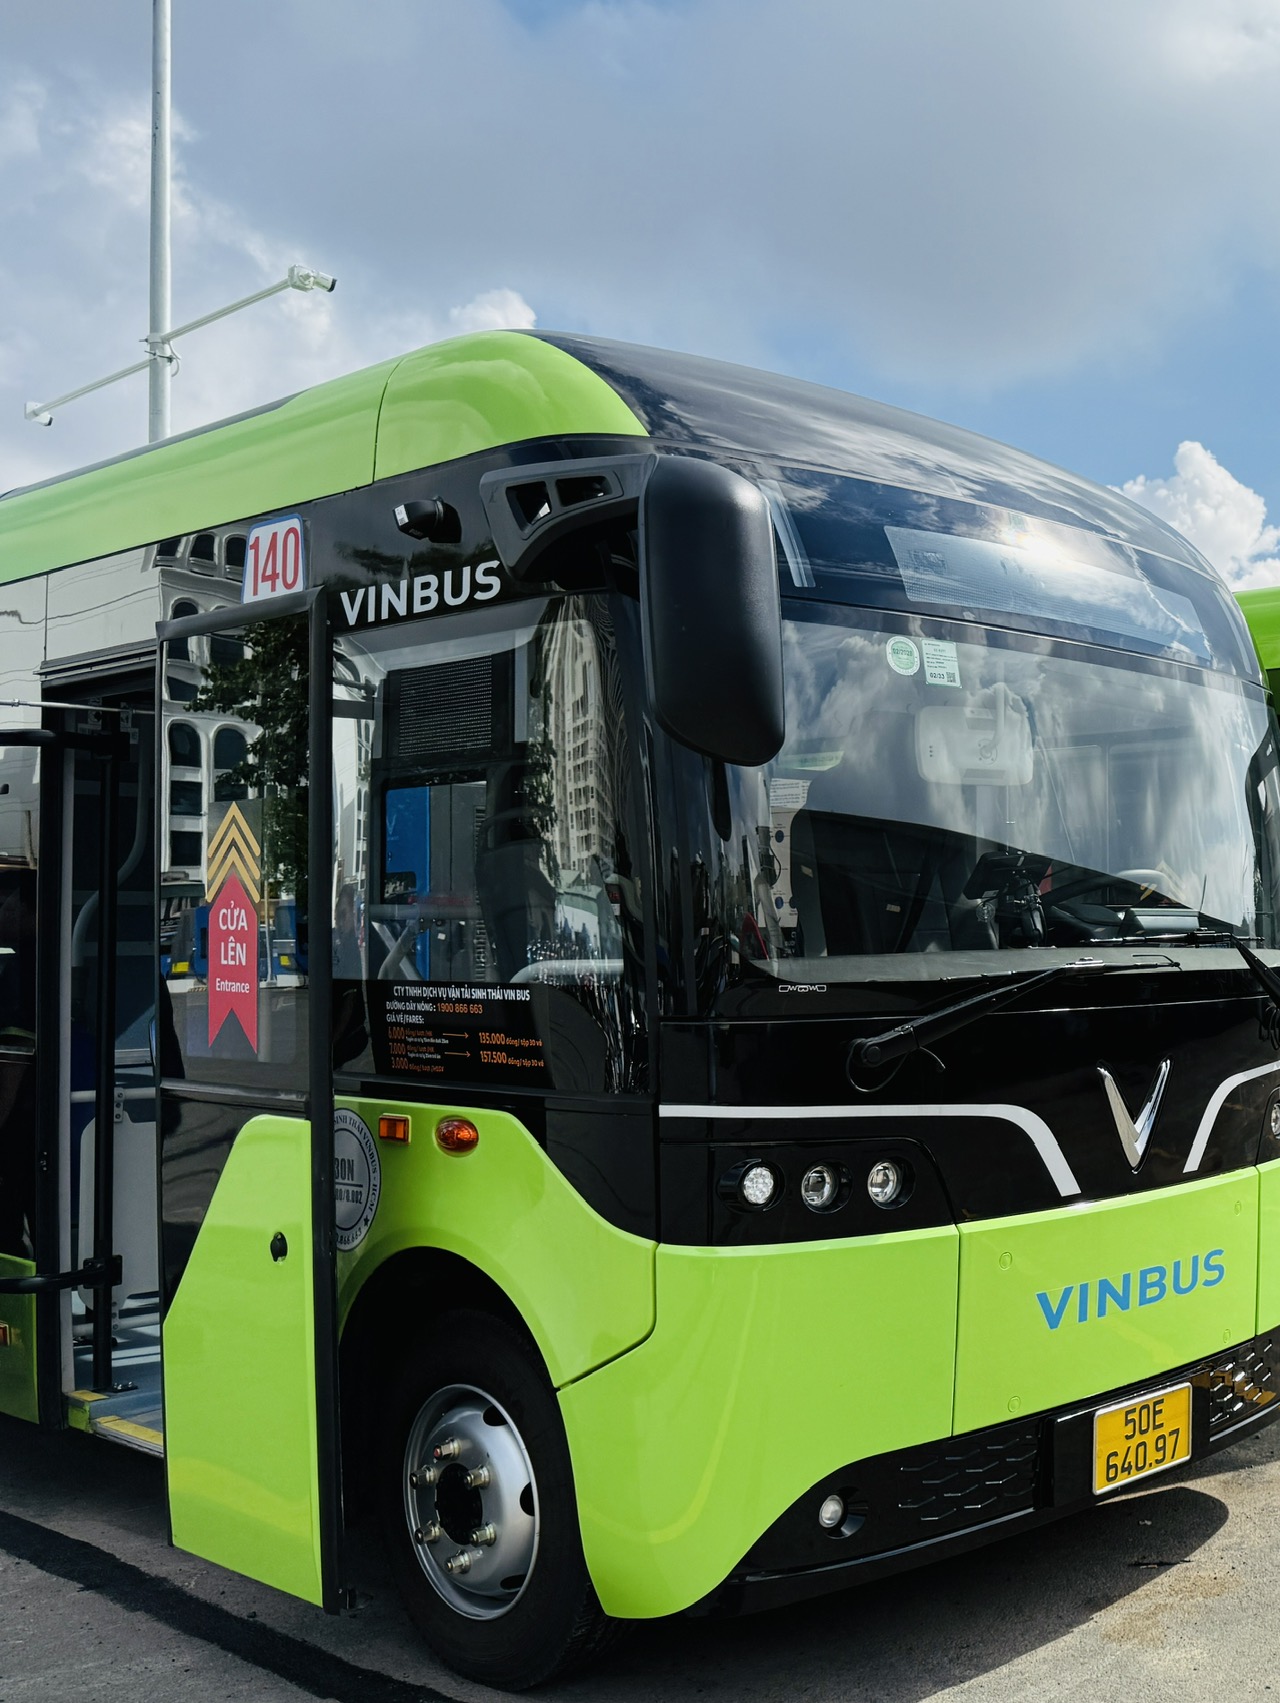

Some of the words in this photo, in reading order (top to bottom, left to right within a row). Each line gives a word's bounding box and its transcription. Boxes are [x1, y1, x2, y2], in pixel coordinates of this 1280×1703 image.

[249, 526, 300, 596] 140
[339, 559, 501, 626] VINBUS
[219, 900, 248, 931] CỬA
[220, 936, 247, 966] LÊN
[215, 978, 250, 994] Entrance
[393, 985, 405, 997] CTY
[405, 985, 422, 997] TNHH
[422, 986, 438, 999] DỊCH
[471, 988, 487, 999] SINH
[487, 985, 503, 1000] THÁI
[503, 989, 516, 1000] VIN
[516, 989, 531, 1001] BUS
[437, 1003, 454, 1013] 1900
[469, 1003, 484, 1014] 663
[479, 1032, 506, 1045] 135.000
[480, 1050, 507, 1064] 157.500
[334, 1114, 347, 1125] INH
[1036, 1248, 1226, 1330] VINBUS
[1124, 1398, 1165, 1441] 50E
[1105, 1427, 1181, 1483] 640.97
